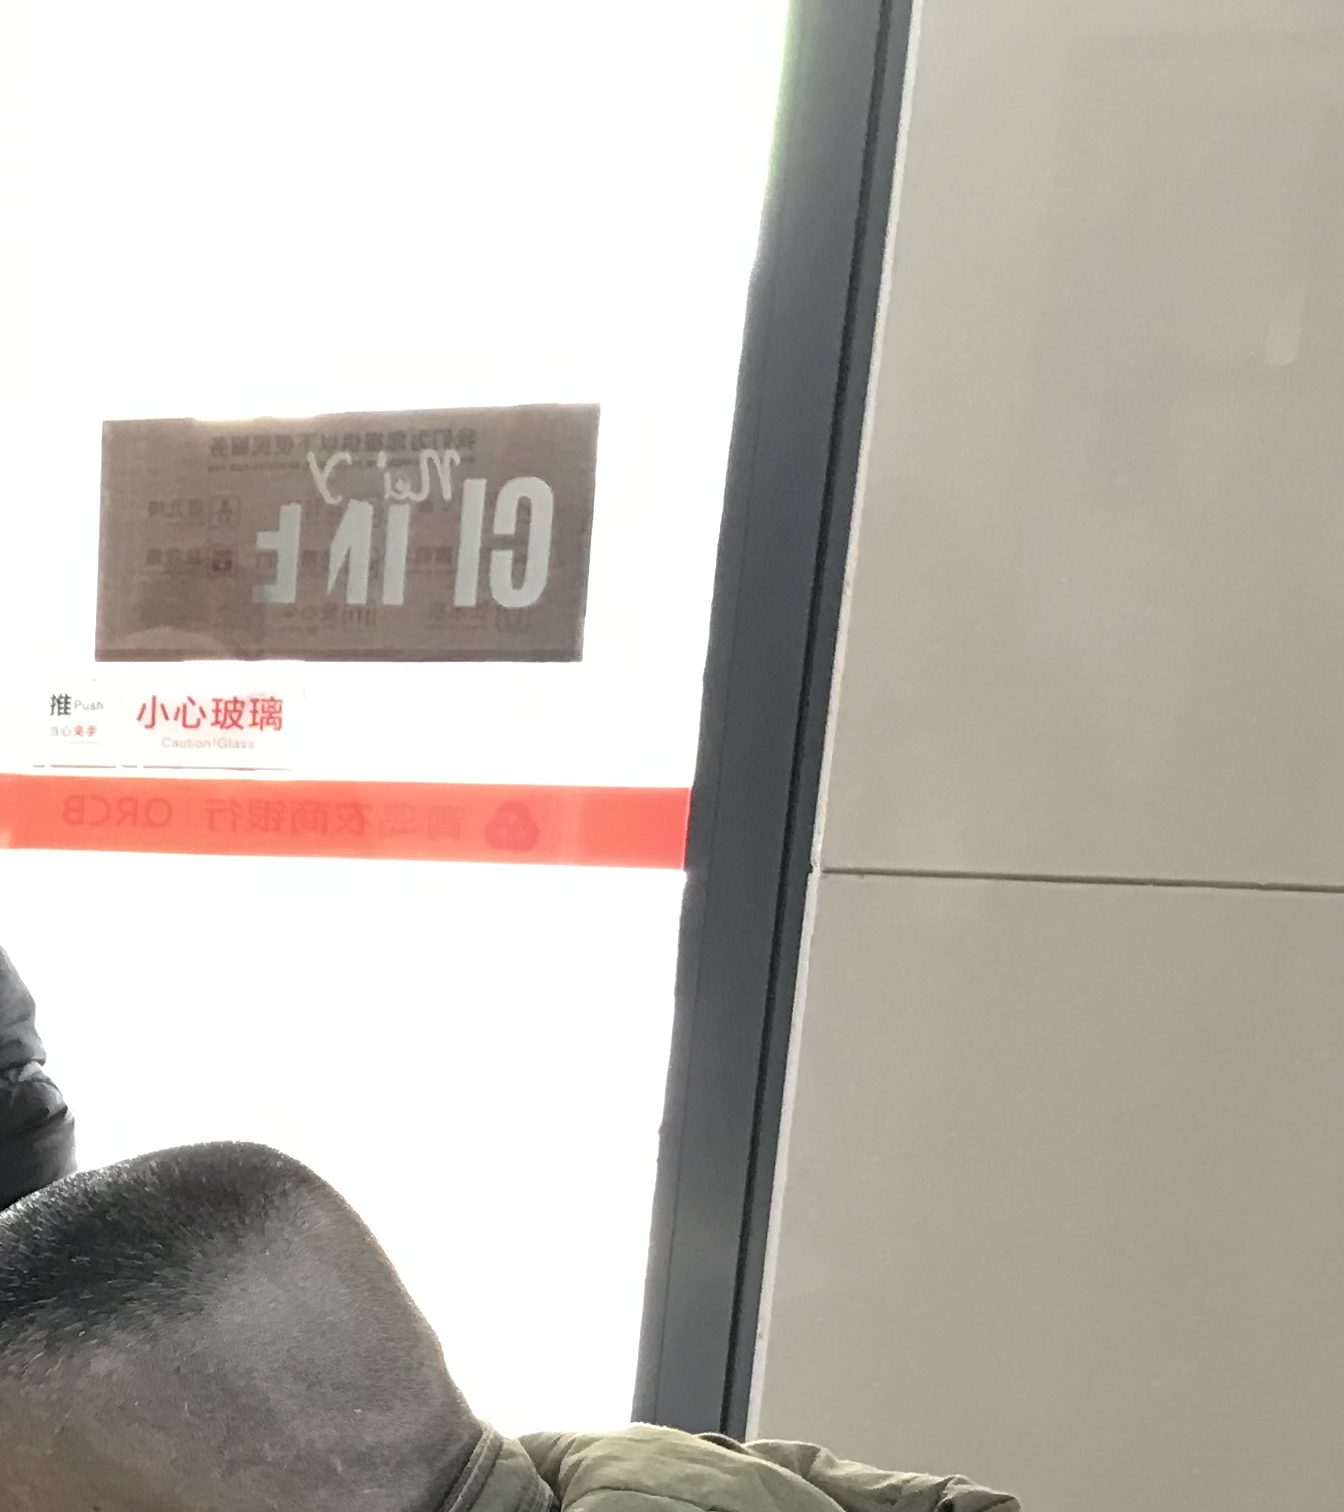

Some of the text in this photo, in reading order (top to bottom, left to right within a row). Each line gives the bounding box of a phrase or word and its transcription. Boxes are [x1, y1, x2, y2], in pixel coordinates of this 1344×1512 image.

[49, 692, 72, 718] 推
[135, 694, 285, 734] 小心玻璃
